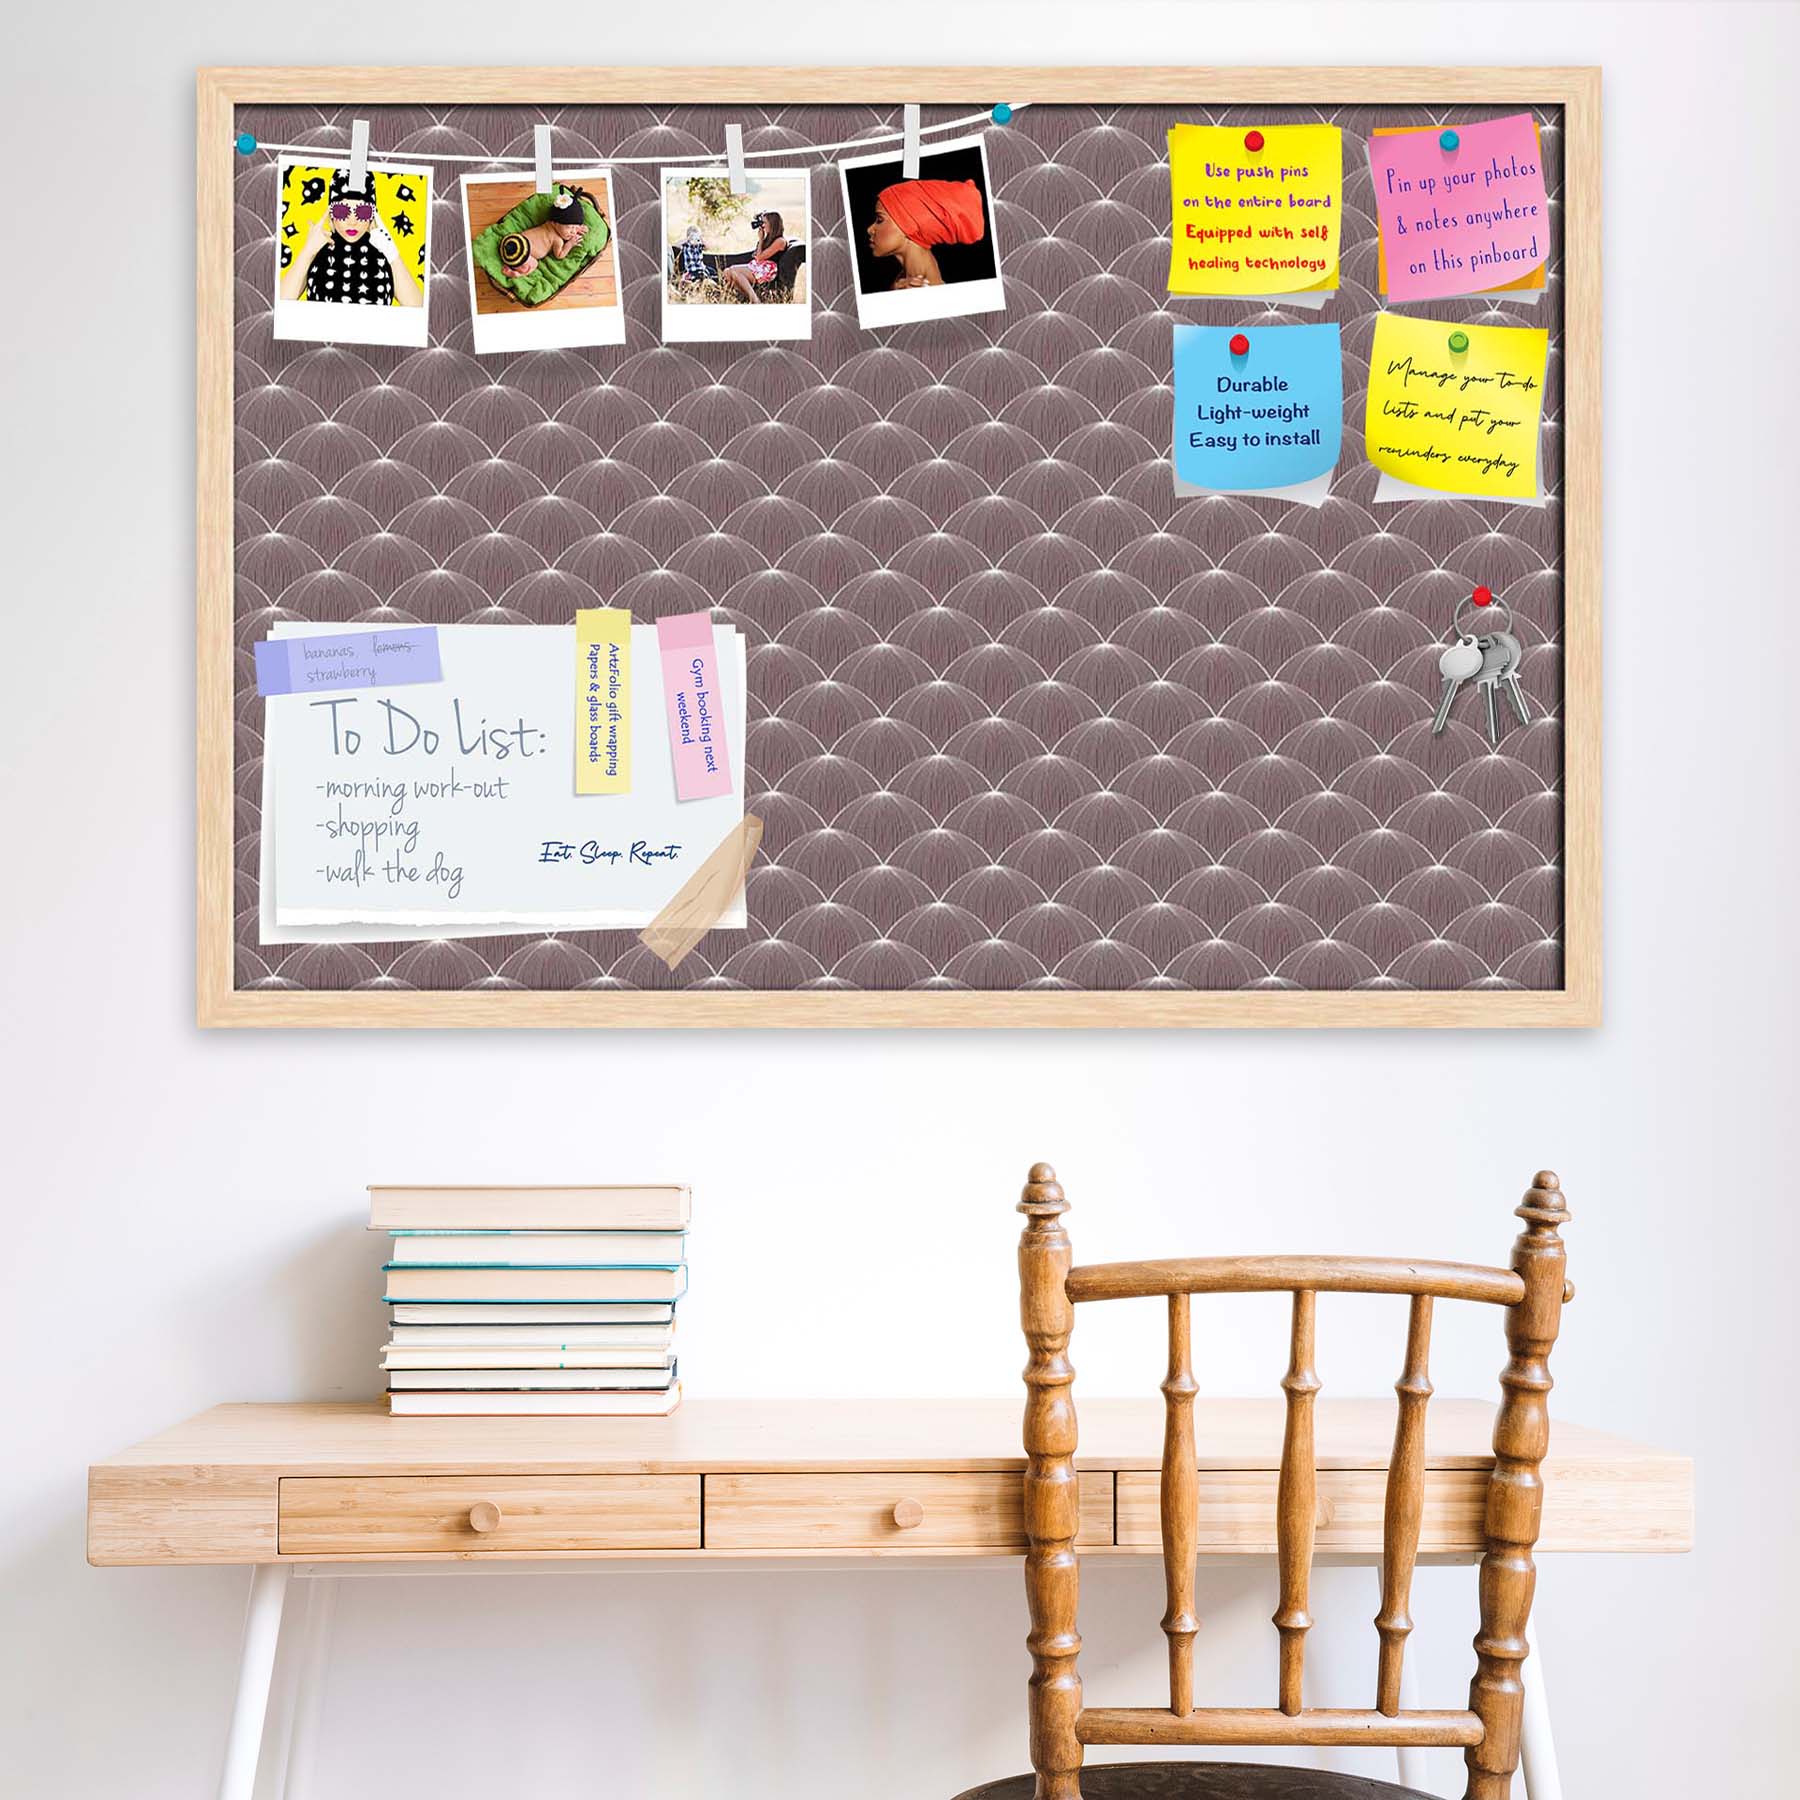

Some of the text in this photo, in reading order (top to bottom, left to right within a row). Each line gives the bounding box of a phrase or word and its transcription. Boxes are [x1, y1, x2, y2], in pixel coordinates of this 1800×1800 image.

[1205, 163, 1309, 182] Use push pins
[1387, 156, 1536, 195] Pin up your photos
[1183, 194, 1331, 208] on the entire board
[1397, 198, 1538, 234] & notes anywhere
[1186, 224, 1328, 243] Equipped with self
[1189, 256, 1326, 272] healing technology
[1410, 236, 1538, 274] on this pinboard
[1217, 376, 1288, 392] Durable
[1388, 357, 1456, 387] Manage
[1463, 374, 1494, 391] your
[1198, 403, 1309, 424] Light-weight
[1424, 408, 1456, 423] and
[1459, 410, 1490, 431] put
[1490, 418, 1520, 434] your
[1190, 429, 1320, 451] Easy to install
[1378, 446, 1519, 477] reminders everyday
[307, 665, 377, 684] strawberry
[586, 644, 601, 763] Papers & glass boards
[605, 643, 622, 776] ArtzFolio gift wrapping
[677, 691, 695, 744] weekend
[690, 658, 718, 772] Gym booking next
[310, 698, 361, 755] To
[377, 699, 439, 755] Do
[414, 766, 510, 799] work-out
[629, 841, 682, 865] Repeat.
[382, 848, 420, 882] the
[426, 852, 464, 899] dog
